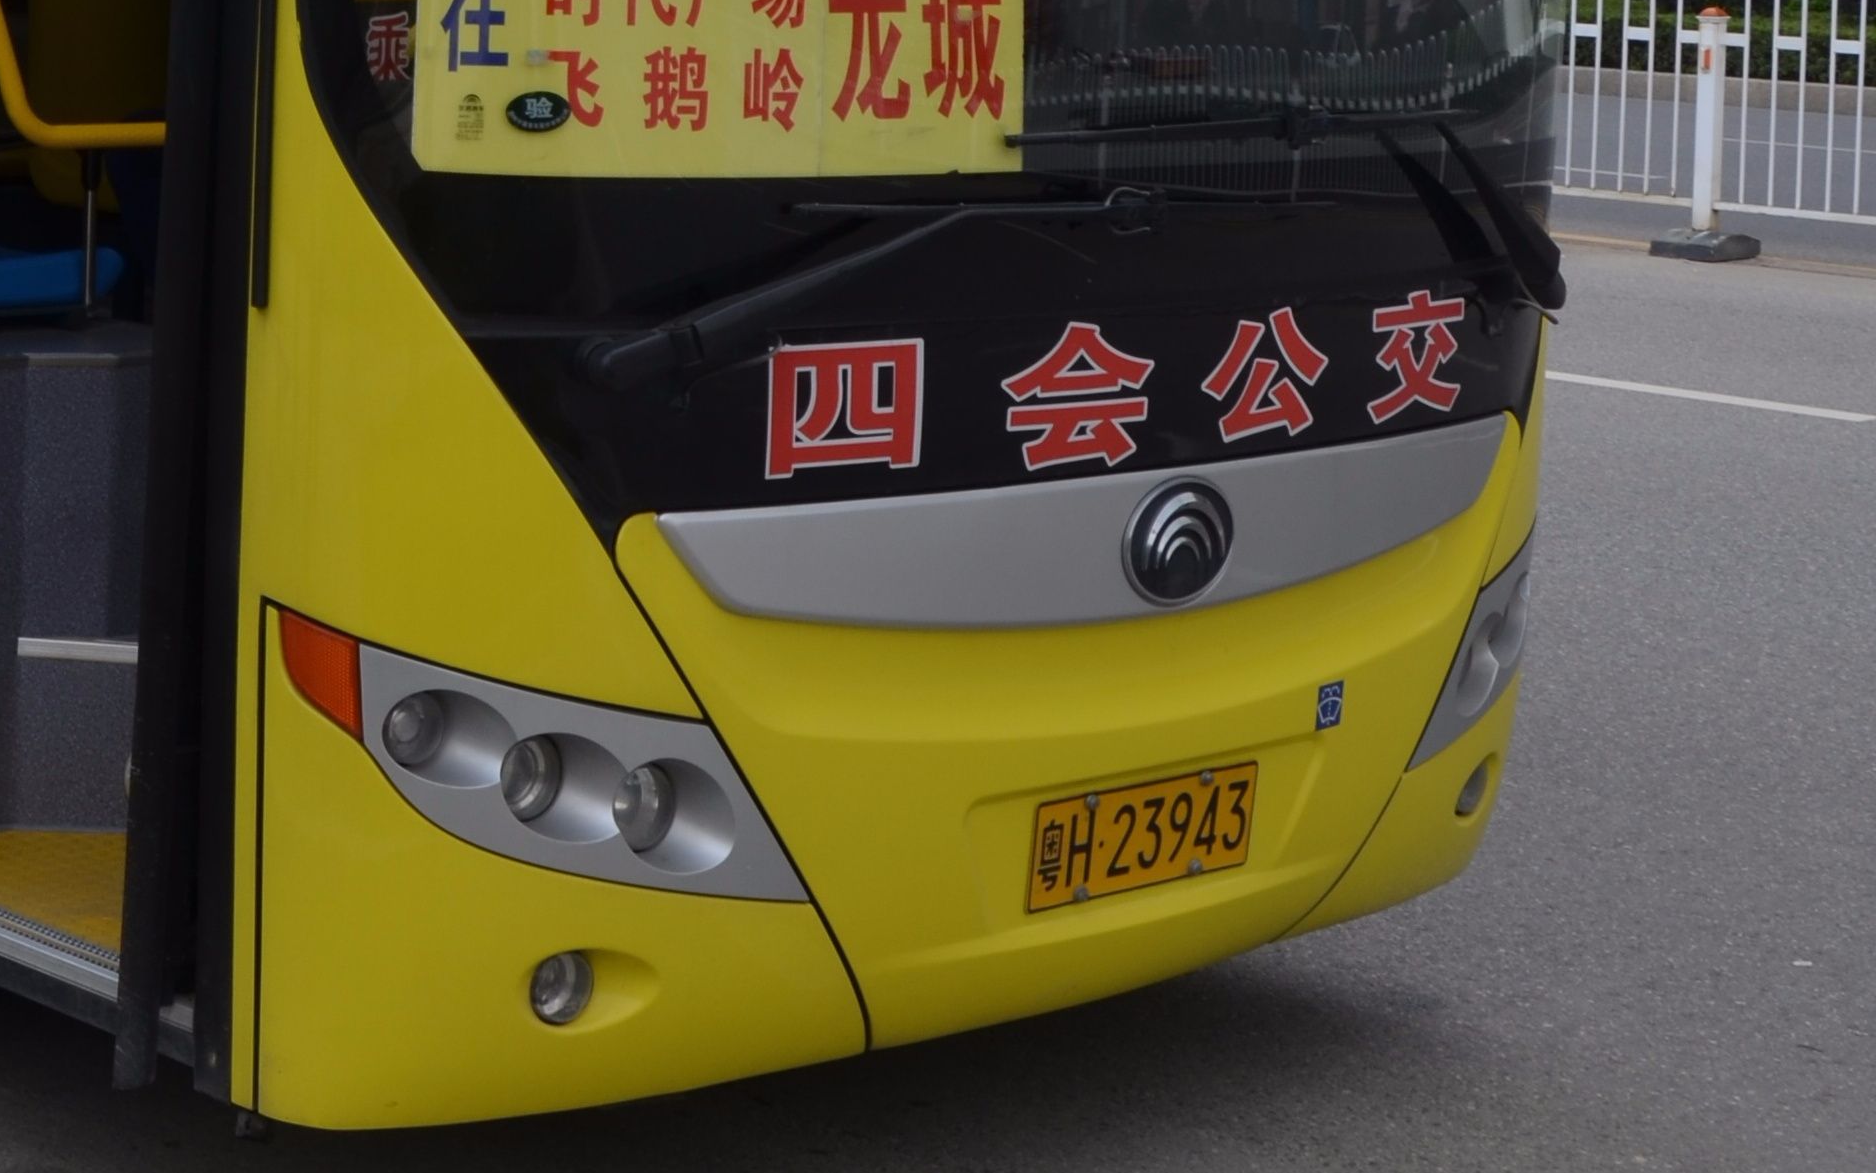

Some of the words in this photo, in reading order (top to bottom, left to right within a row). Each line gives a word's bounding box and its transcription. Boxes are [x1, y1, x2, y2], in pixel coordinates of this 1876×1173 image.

[546, 46, 804, 132] 飞鹅岭
[764, 290, 1466, 480] 四会公交
